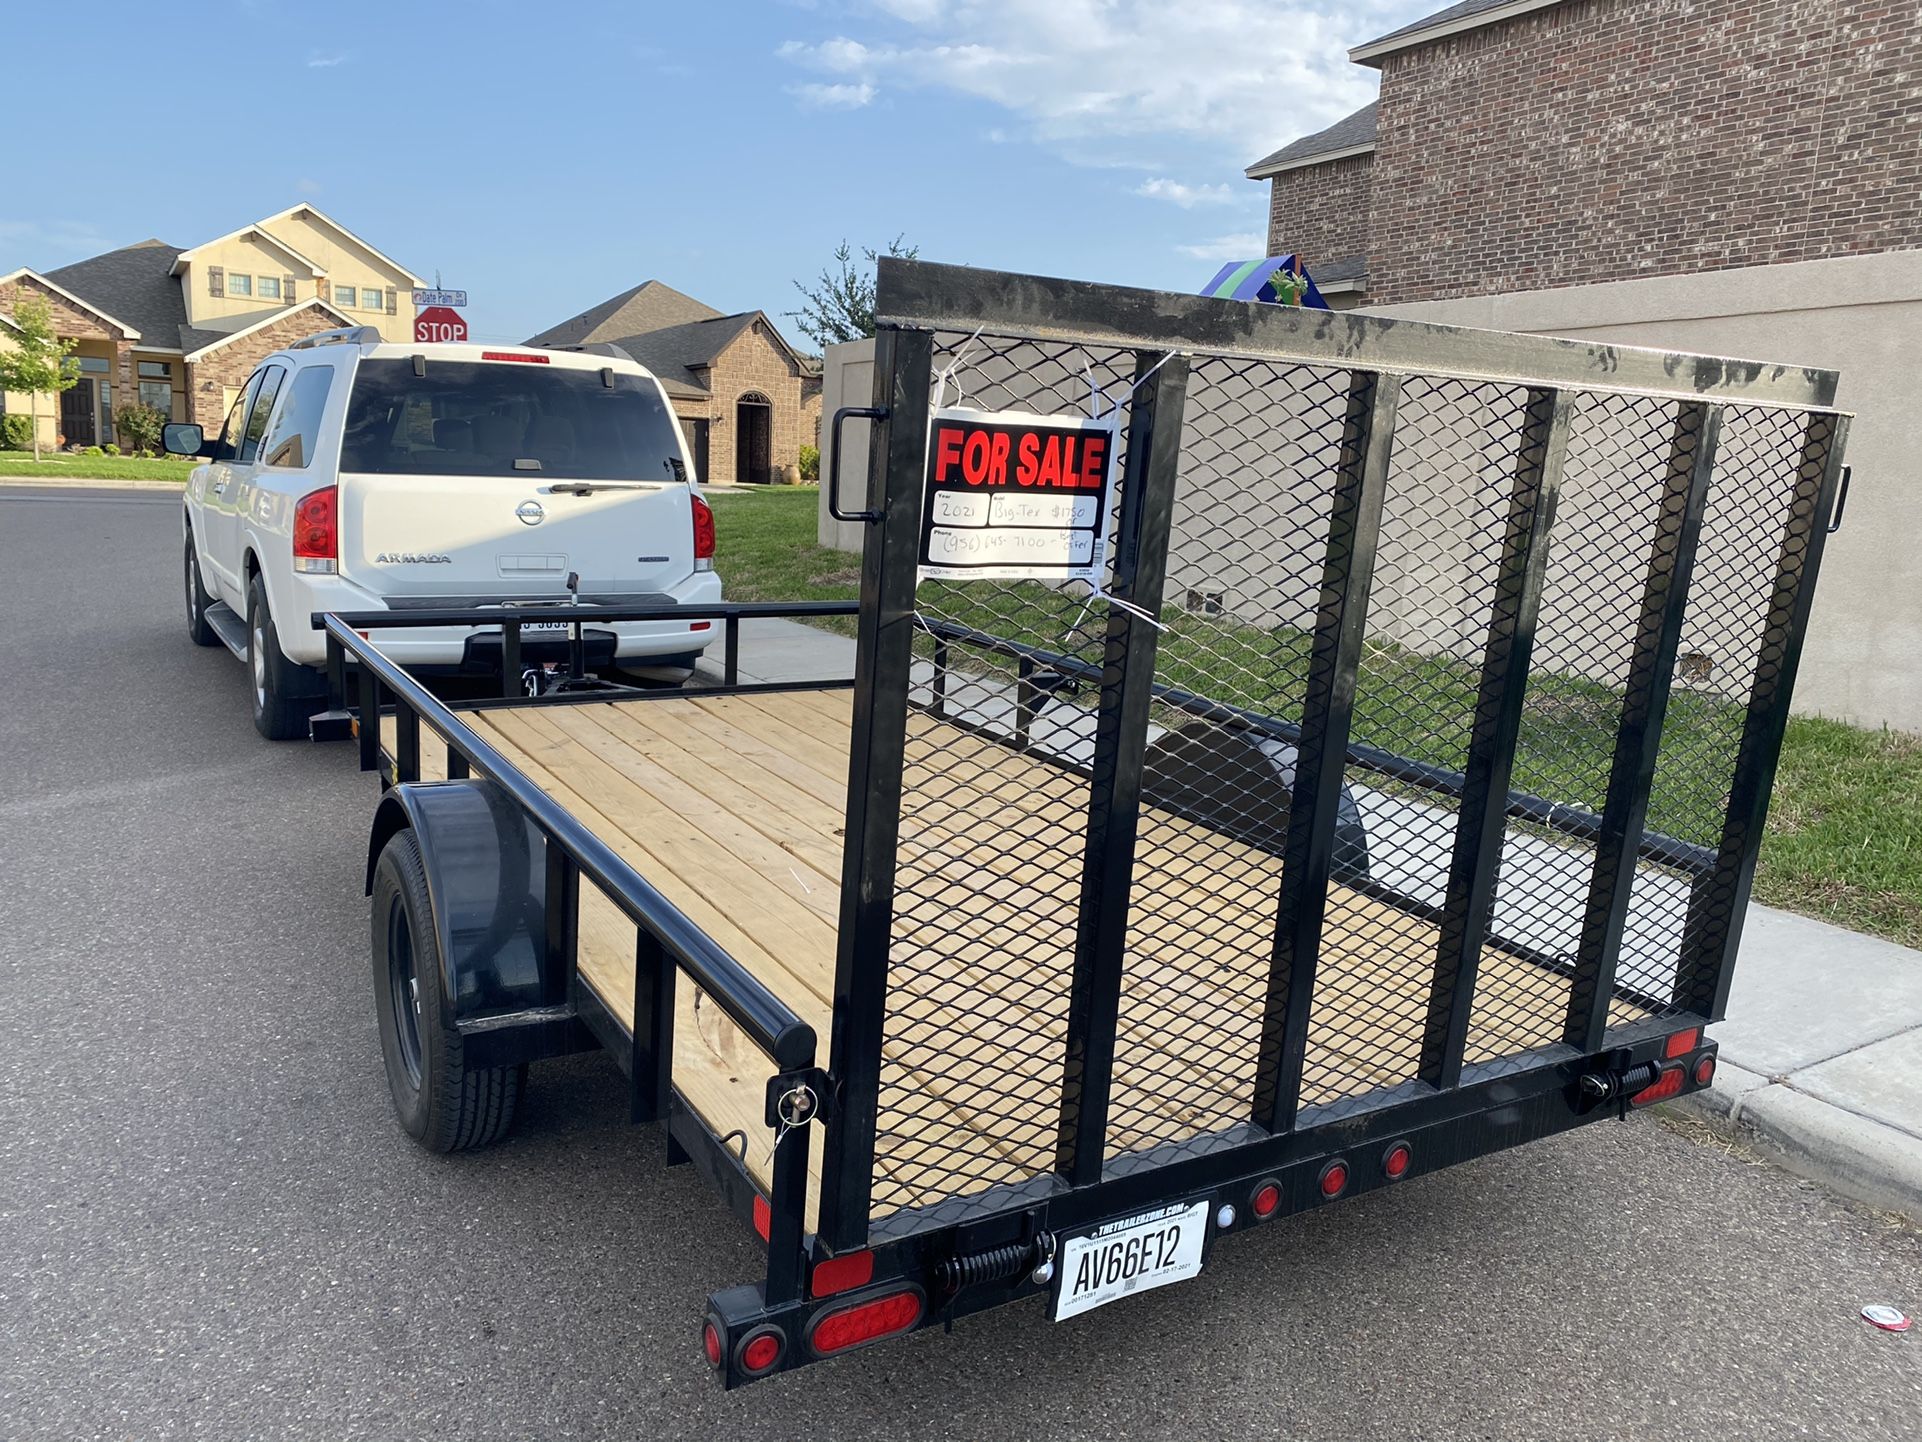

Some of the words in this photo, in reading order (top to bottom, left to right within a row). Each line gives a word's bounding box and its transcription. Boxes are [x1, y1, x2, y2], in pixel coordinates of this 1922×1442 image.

[422, 291, 437, 304] Date
[438, 291, 453, 304] Palm
[417, 322, 465, 341] STOP
[935, 428, 1010, 485] FOR
[1016, 432, 1105, 488] SALE
[942, 502, 975, 517] 2021
[943, 534, 980, 553] (956)
[376, 553, 452, 563] ARMADA
[1098, 1203, 1184, 1237] THETRAILERZONE.COM
[1073, 1225, 1181, 1296] AV66E12
